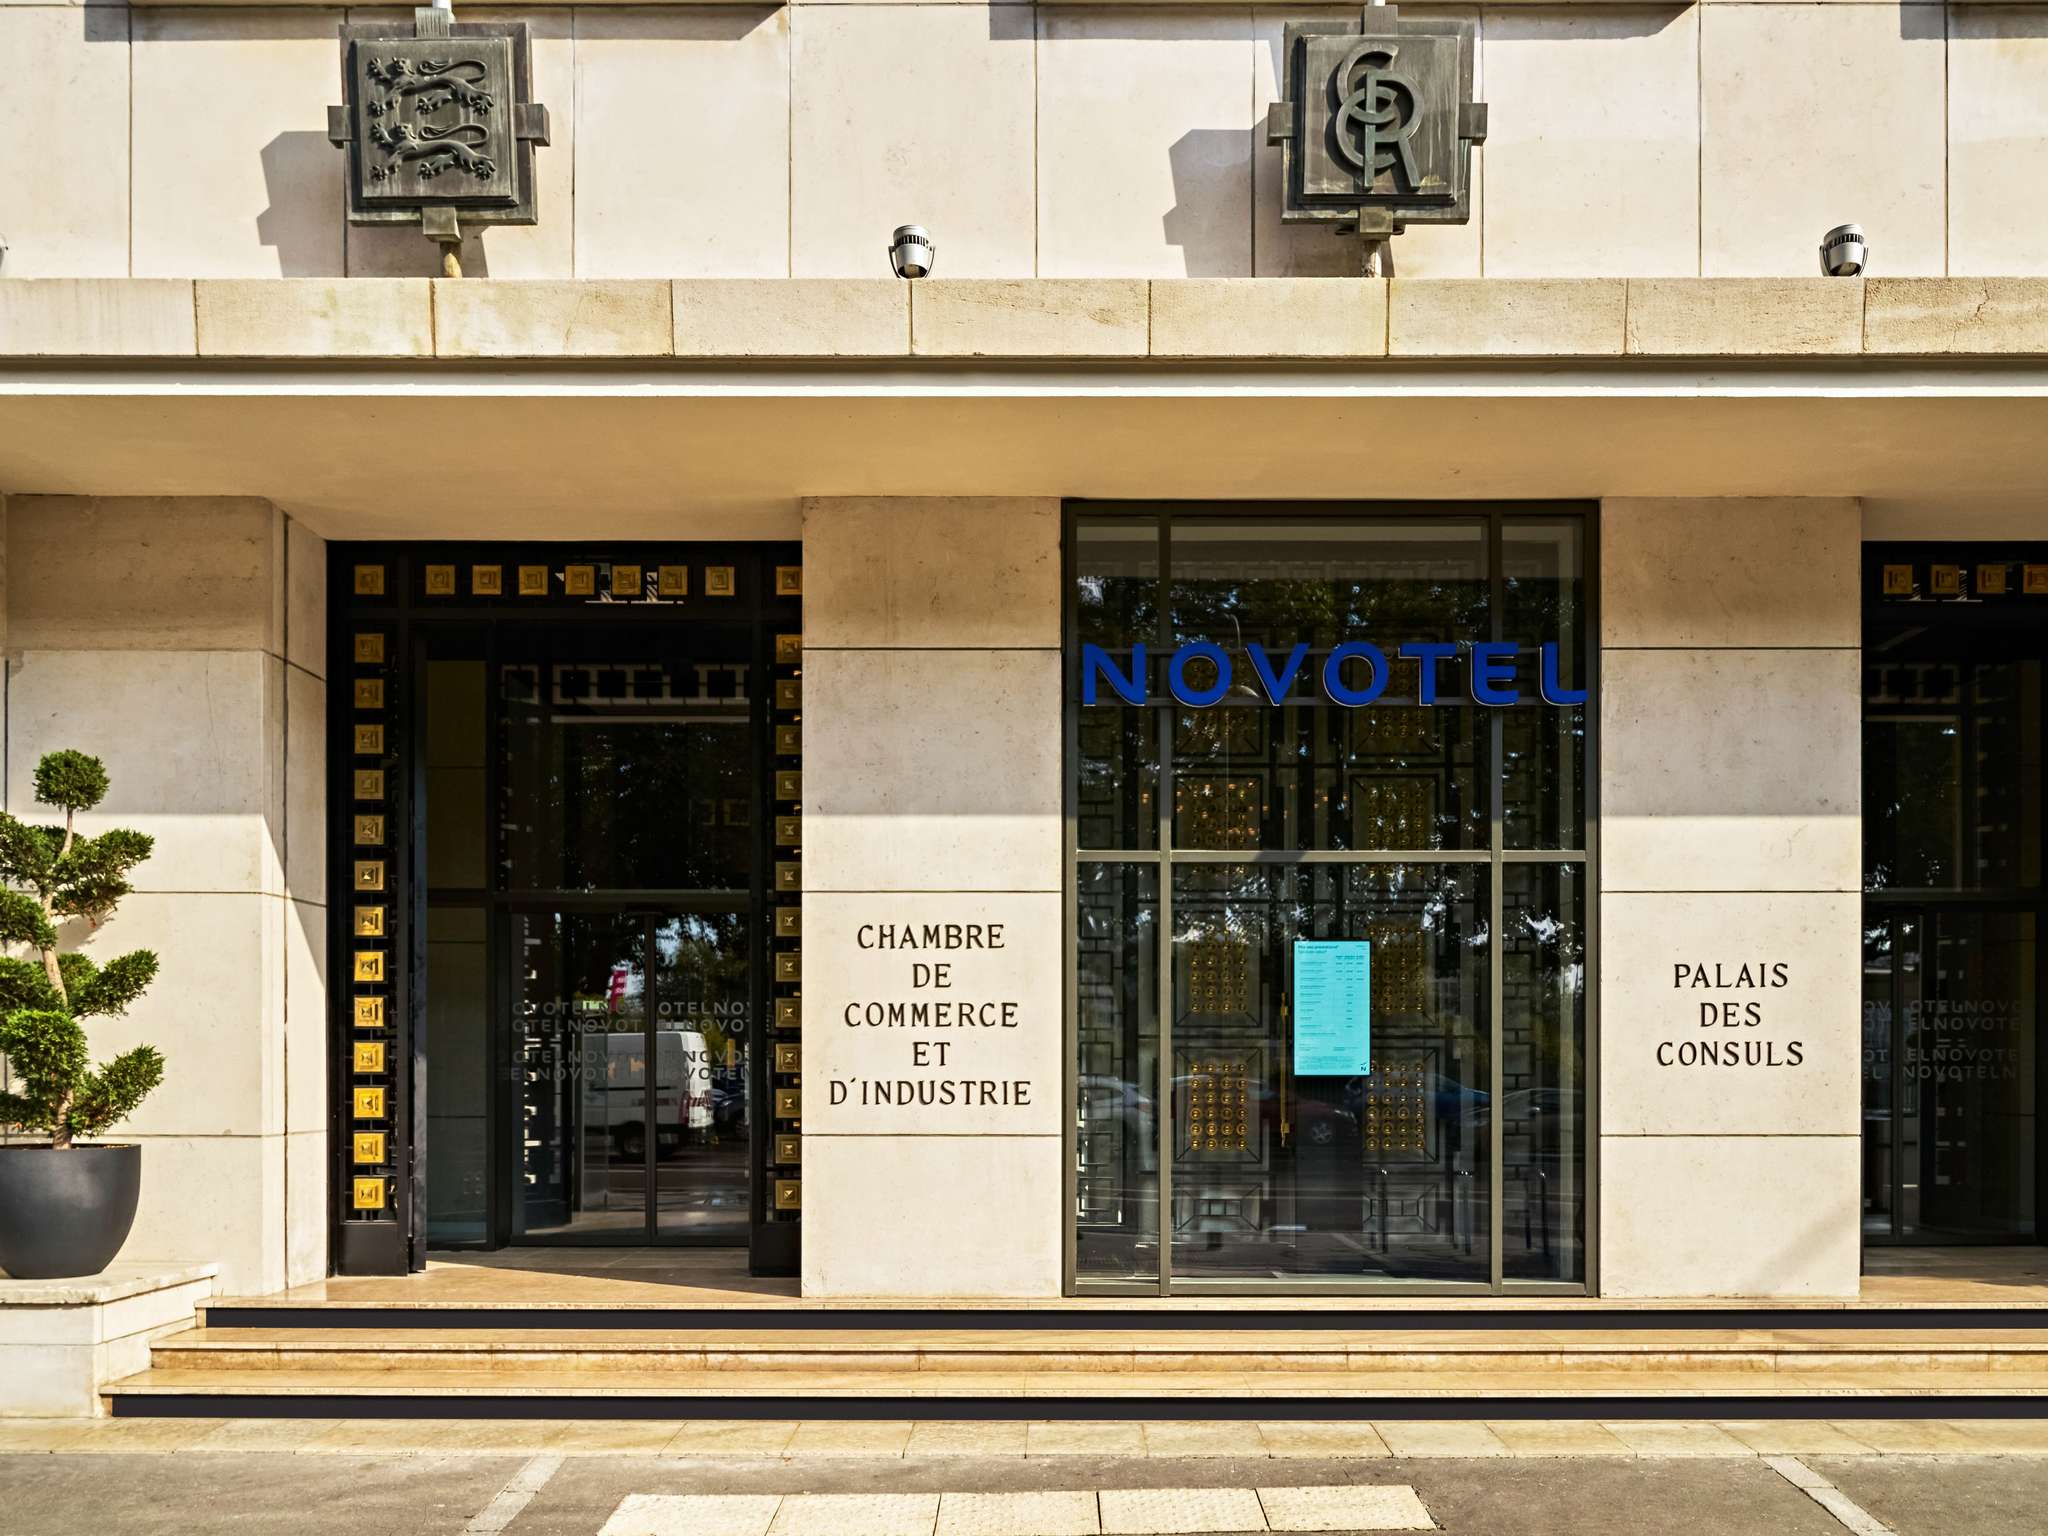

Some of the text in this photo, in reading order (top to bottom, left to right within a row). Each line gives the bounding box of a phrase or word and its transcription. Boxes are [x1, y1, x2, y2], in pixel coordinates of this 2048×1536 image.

[1082, 641, 1588, 707] NOVOTEL
[857, 924, 1005, 949] CHAMBRE
[912, 963, 952, 988] DE
[1673, 962, 1788, 988] PALAIS
[844, 1002, 1018, 1027] COMMERCE
[1700, 1002, 1761, 1027] DES
[912, 1042, 951, 1066] ET
[1656, 1041, 1803, 1066] CONSULS
